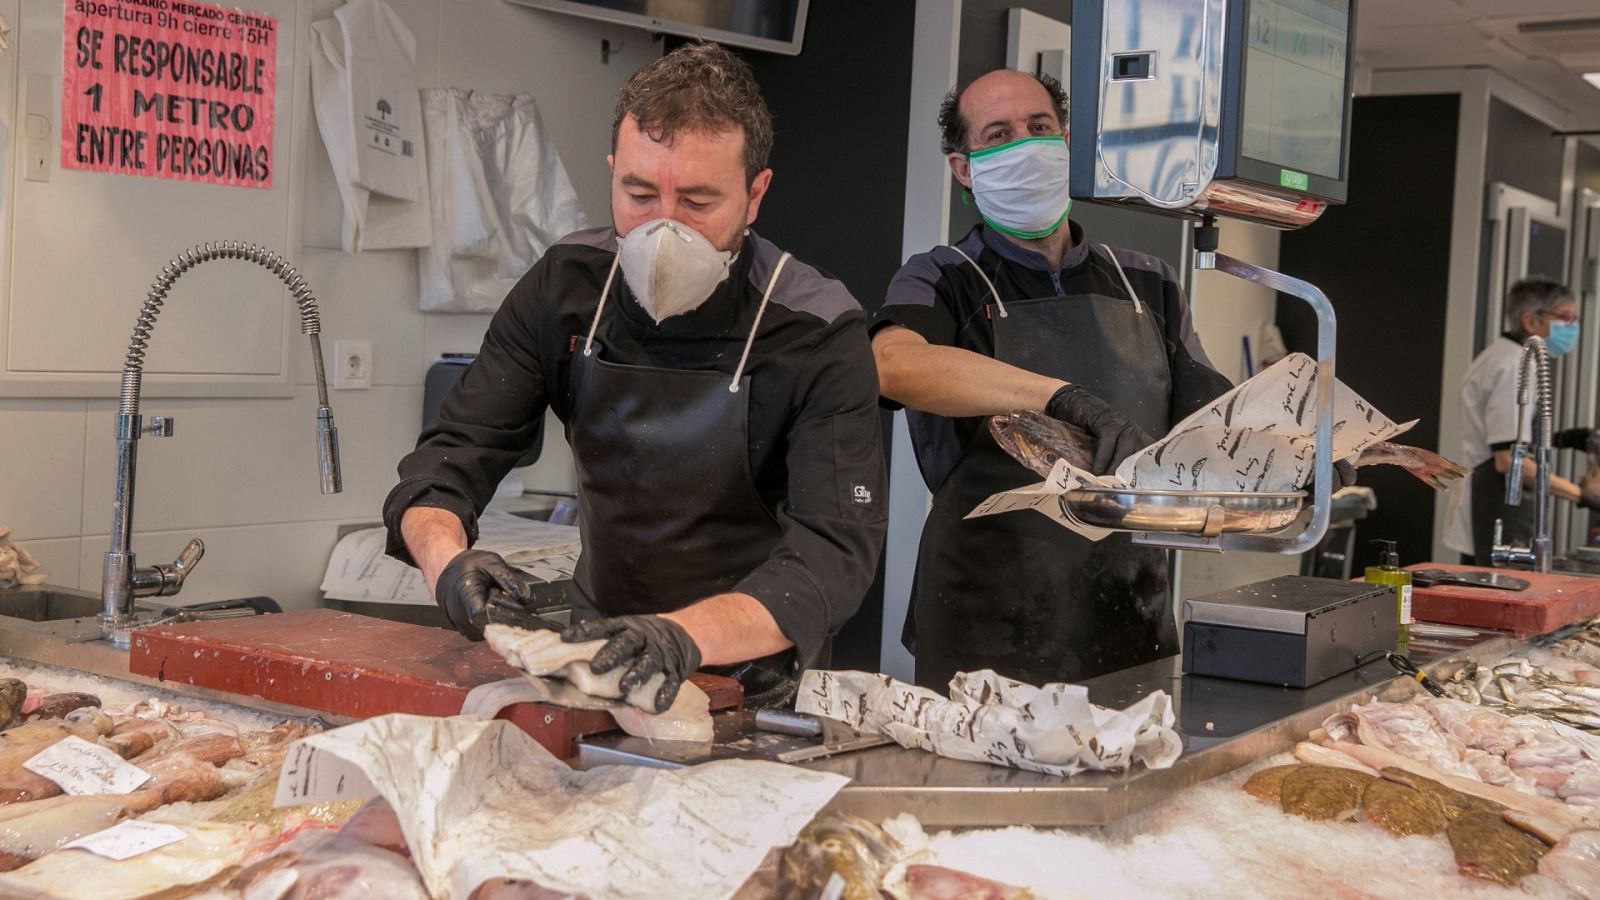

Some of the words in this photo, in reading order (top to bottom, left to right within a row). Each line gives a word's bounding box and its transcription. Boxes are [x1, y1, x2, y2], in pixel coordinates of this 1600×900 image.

[75, 0, 152, 25] apertura
[158, 11, 178, 30] 9h
[183, 17, 232, 39] cierre
[238, 28, 268, 46] 15H
[172, 2, 224, 21] MERCADO
[228, 13, 274, 31] CENTRAL
[76, 26, 104, 70] SE
[114, 33, 266, 95] RESPONSABLE
[83, 82, 104, 113] 1
[133, 89, 255, 133] METRO
[75, 123, 148, 170] ENTRE
[155, 133, 270, 182] PERSONAS
